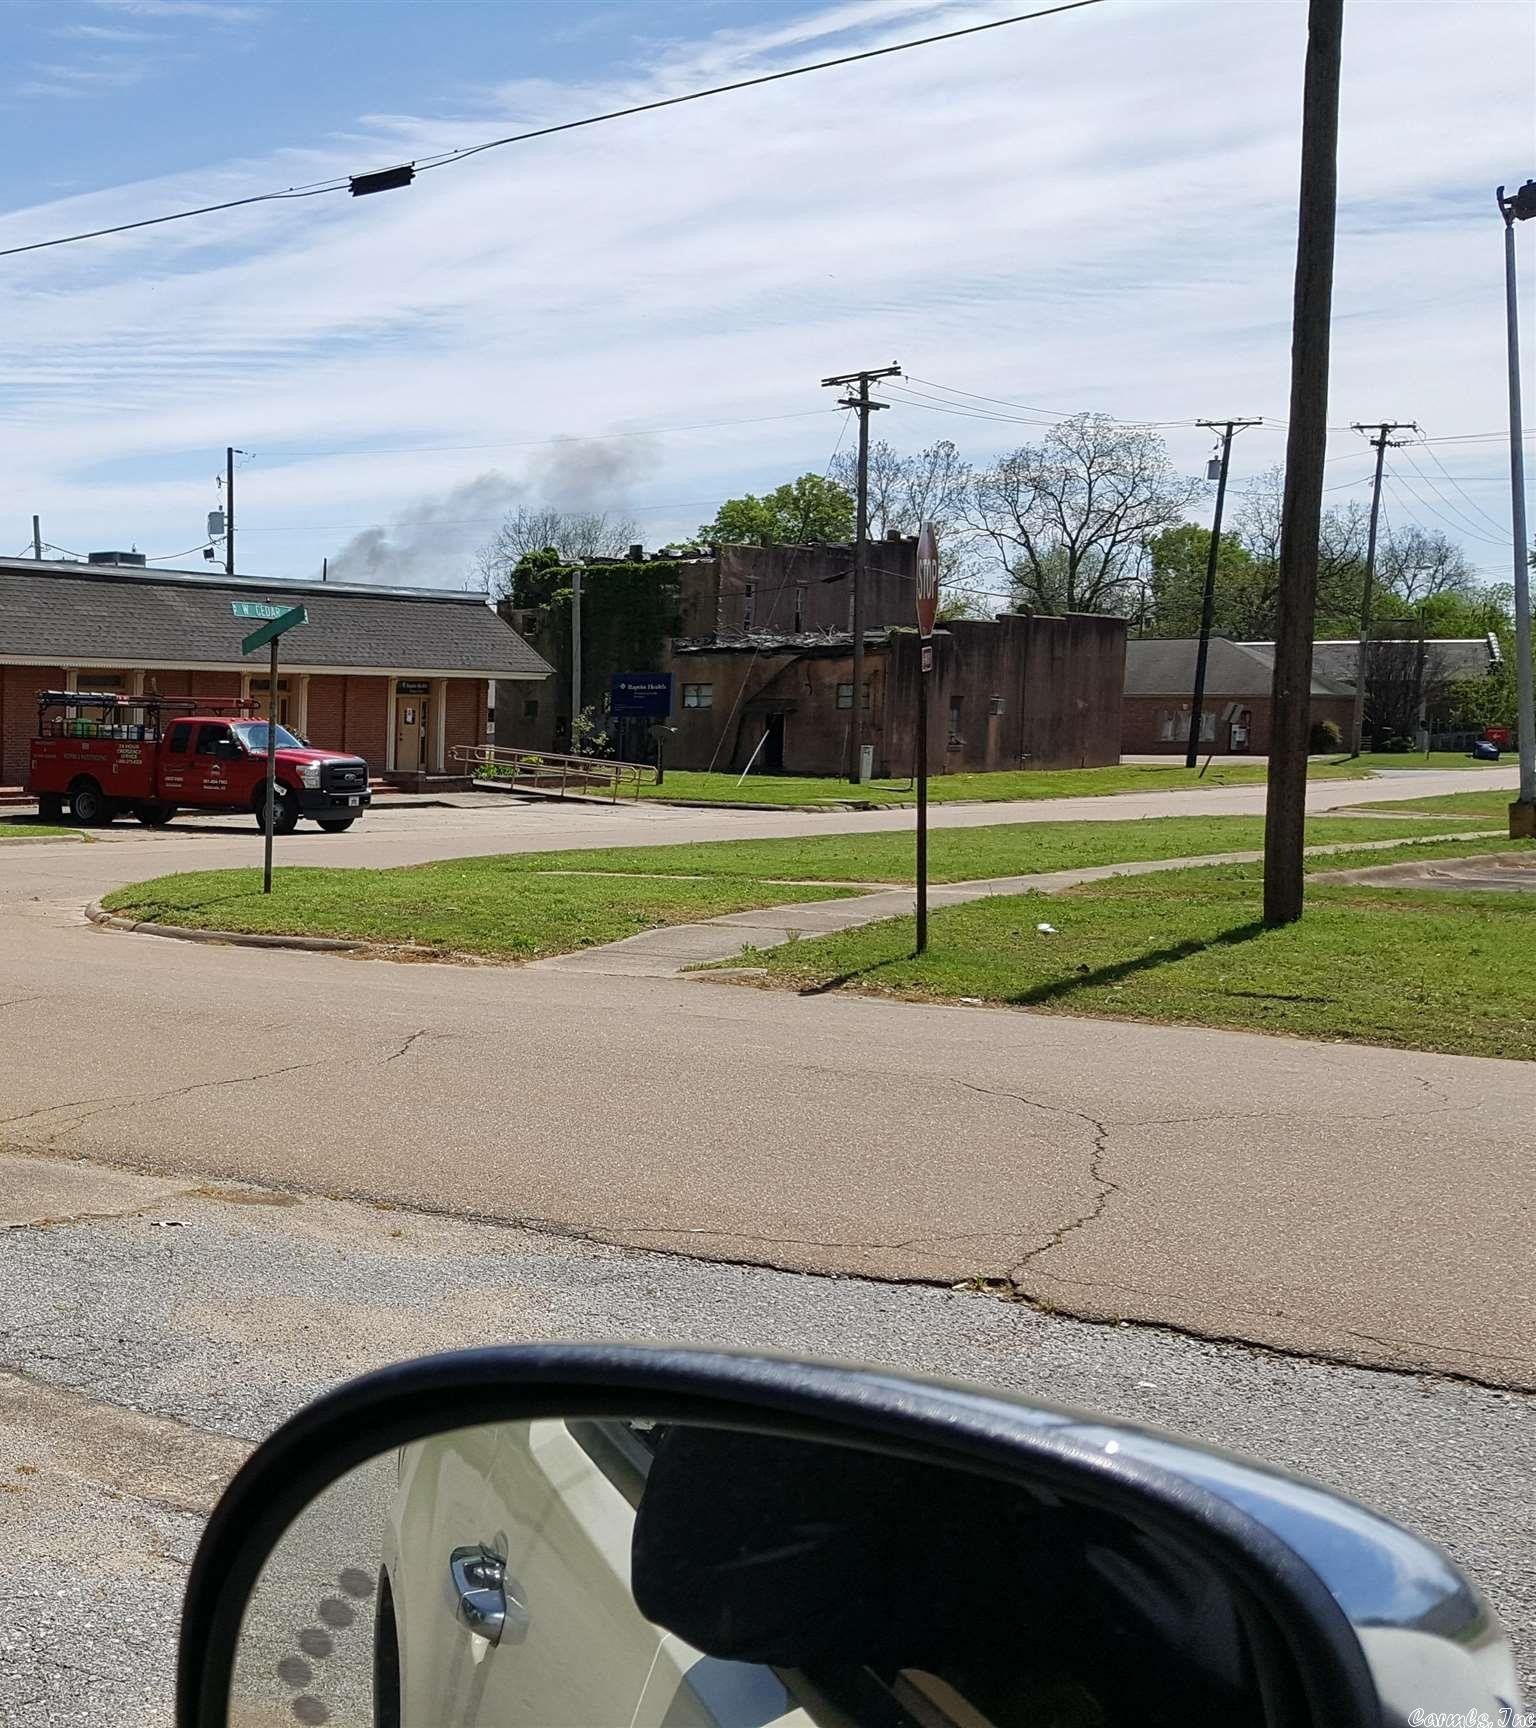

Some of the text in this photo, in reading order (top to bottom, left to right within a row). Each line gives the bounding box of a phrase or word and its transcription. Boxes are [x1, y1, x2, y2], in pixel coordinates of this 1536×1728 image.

[918, 558, 936, 600] STOP
[242, 604, 281, 618] W CEDAR
